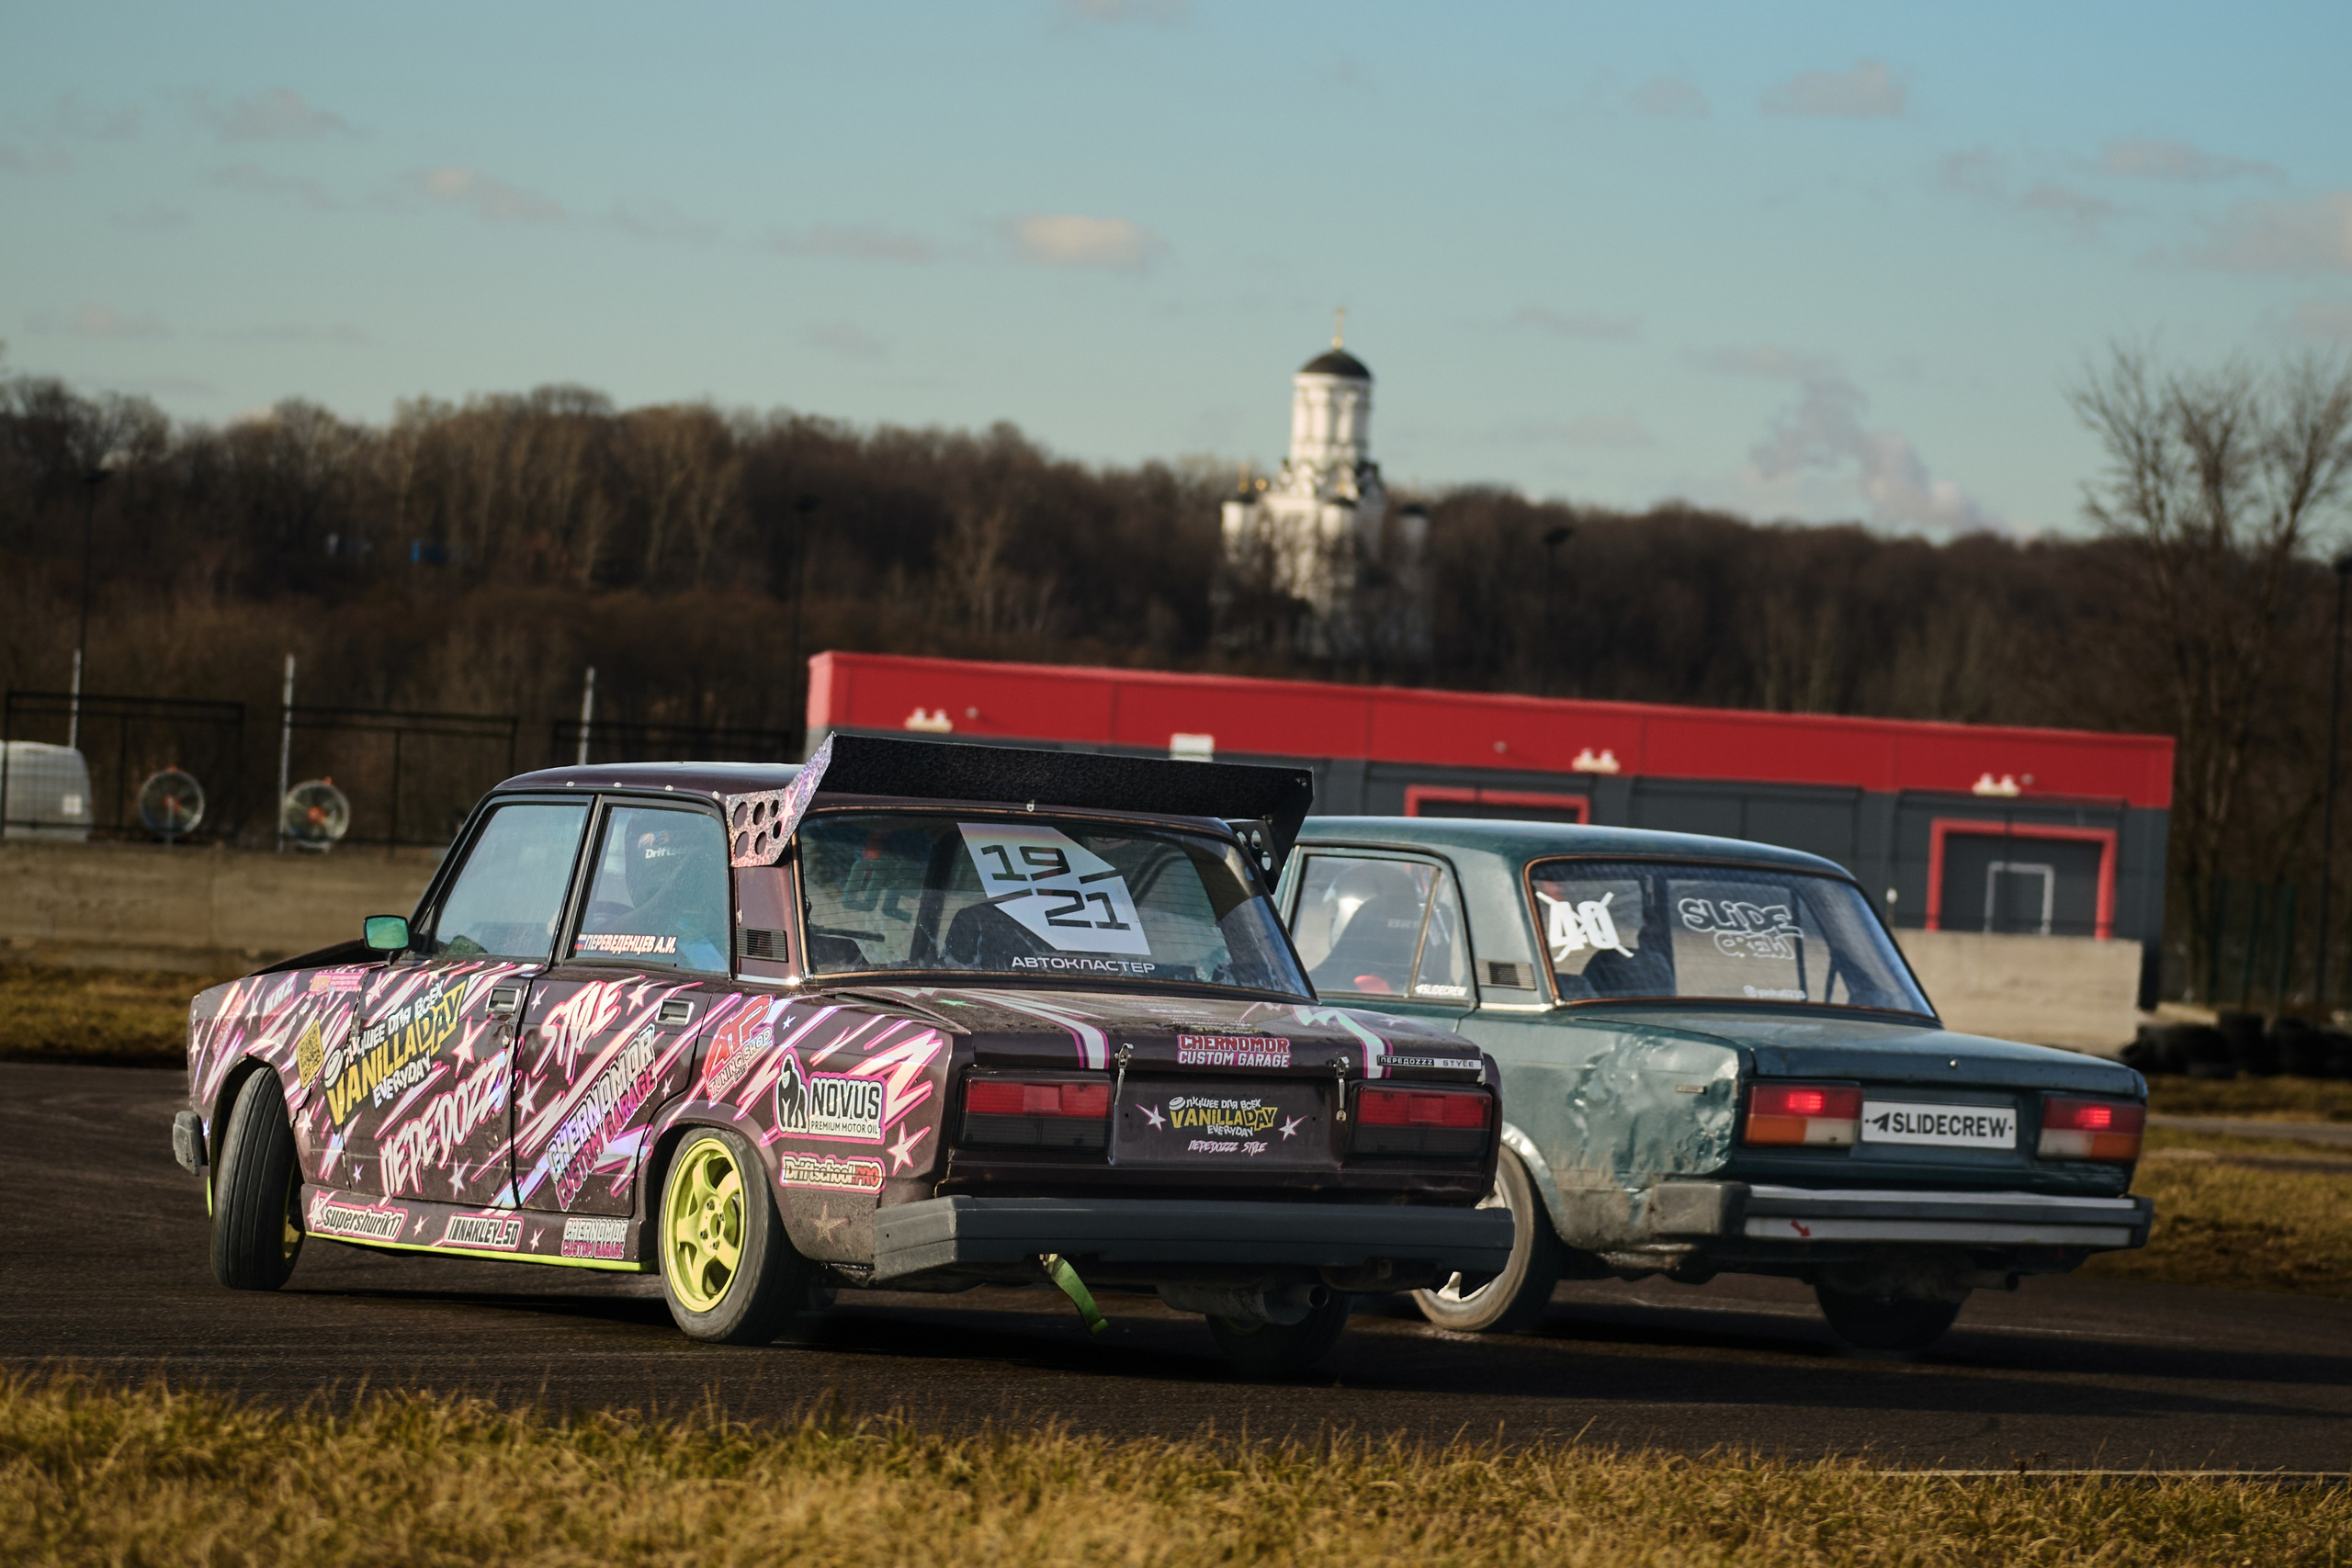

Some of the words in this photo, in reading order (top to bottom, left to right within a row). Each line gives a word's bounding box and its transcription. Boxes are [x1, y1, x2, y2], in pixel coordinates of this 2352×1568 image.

[981, 844, 1071, 881] 19
[1035, 887, 1131, 931] 21
[583, 934, 655, 956] ПЕРЕВЕДЕНЦЕВ
[1012, 955, 1156, 974] АВТОКЛАСТЕР
[1179, 1034, 1289, 1054] CHERNOMOR
[708, 1052, 742, 1097] TUNING
[743, 1027, 772, 1062] SHOP
[1179, 1051, 1234, 1066] CUSTOM
[1238, 1053, 1289, 1067] GARAGE
[1442, 1059, 1475, 1067] STYLE
[373, 1050, 432, 1109] EVERYDAY
[548, 1029, 654, 1174] CHERNOMOR
[604, 1065, 657, 1144] GARAGE
[811, 1081, 881, 1120] NOVUS
[811, 1121, 841, 1132] PREMIUM
[842, 1122, 866, 1134] MOTOR
[867, 1123, 878, 1134] OIL
[1207, 1123, 1254, 1137] EVERYDAY
[1893, 1113, 2008, 1138] SLIDECREW
[323, 1208, 402, 1237] supershurik17
[565, 1220, 628, 1242] CHERNOMOR
[562, 1240, 593, 1257] CUSTOM
[594, 1243, 624, 1258] GARAGE
